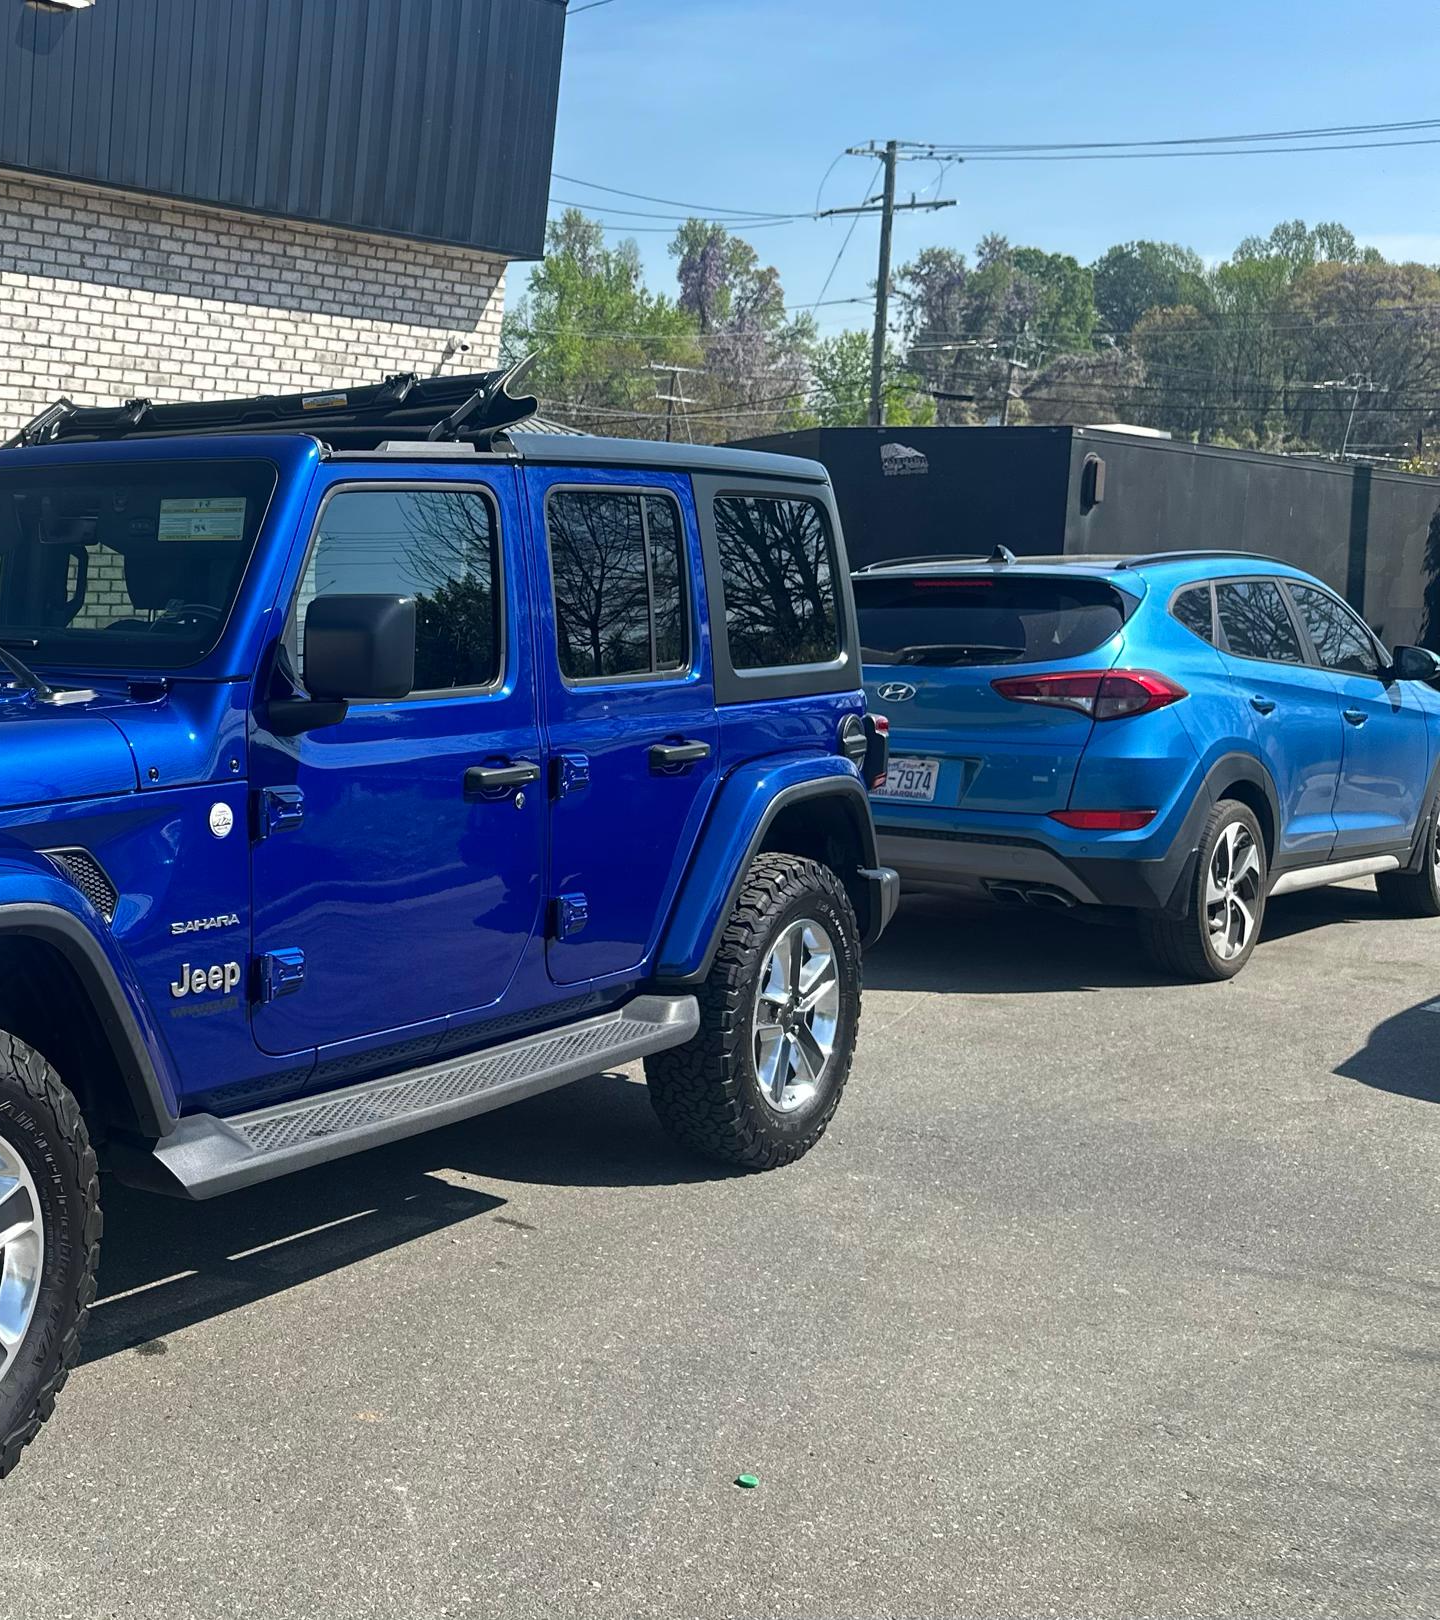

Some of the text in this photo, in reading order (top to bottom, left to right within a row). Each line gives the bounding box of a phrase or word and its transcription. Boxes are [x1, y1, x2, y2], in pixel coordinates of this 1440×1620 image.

[888, 770, 932, 791] -7974
[170, 914, 241, 935] SAHARA
[170, 961, 241, 998] Jeep
